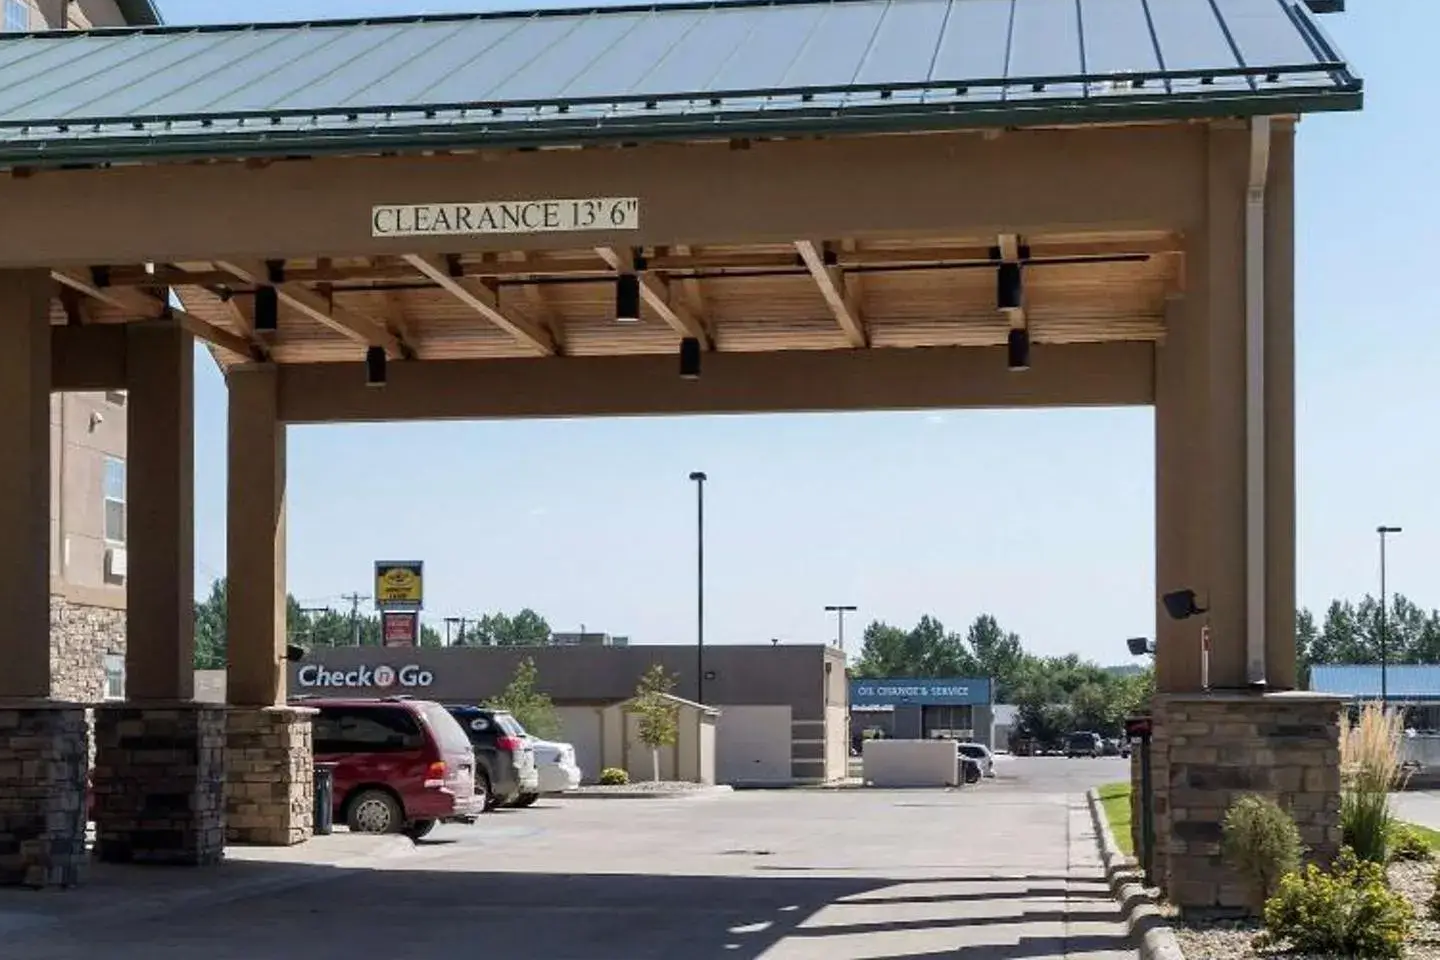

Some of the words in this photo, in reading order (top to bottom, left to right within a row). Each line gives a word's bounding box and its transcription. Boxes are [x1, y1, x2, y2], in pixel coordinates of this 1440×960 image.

[373, 204, 560, 234] CLEARANCE
[572, 201, 602, 227] 13'
[609, 199, 637, 226] 6"
[299, 664, 371, 686] Check
[399, 665, 433, 686] Go
[858, 686, 875, 696] OIL
[877, 686, 919, 696] CHANGE
[931, 686, 968, 696] SERVICE
